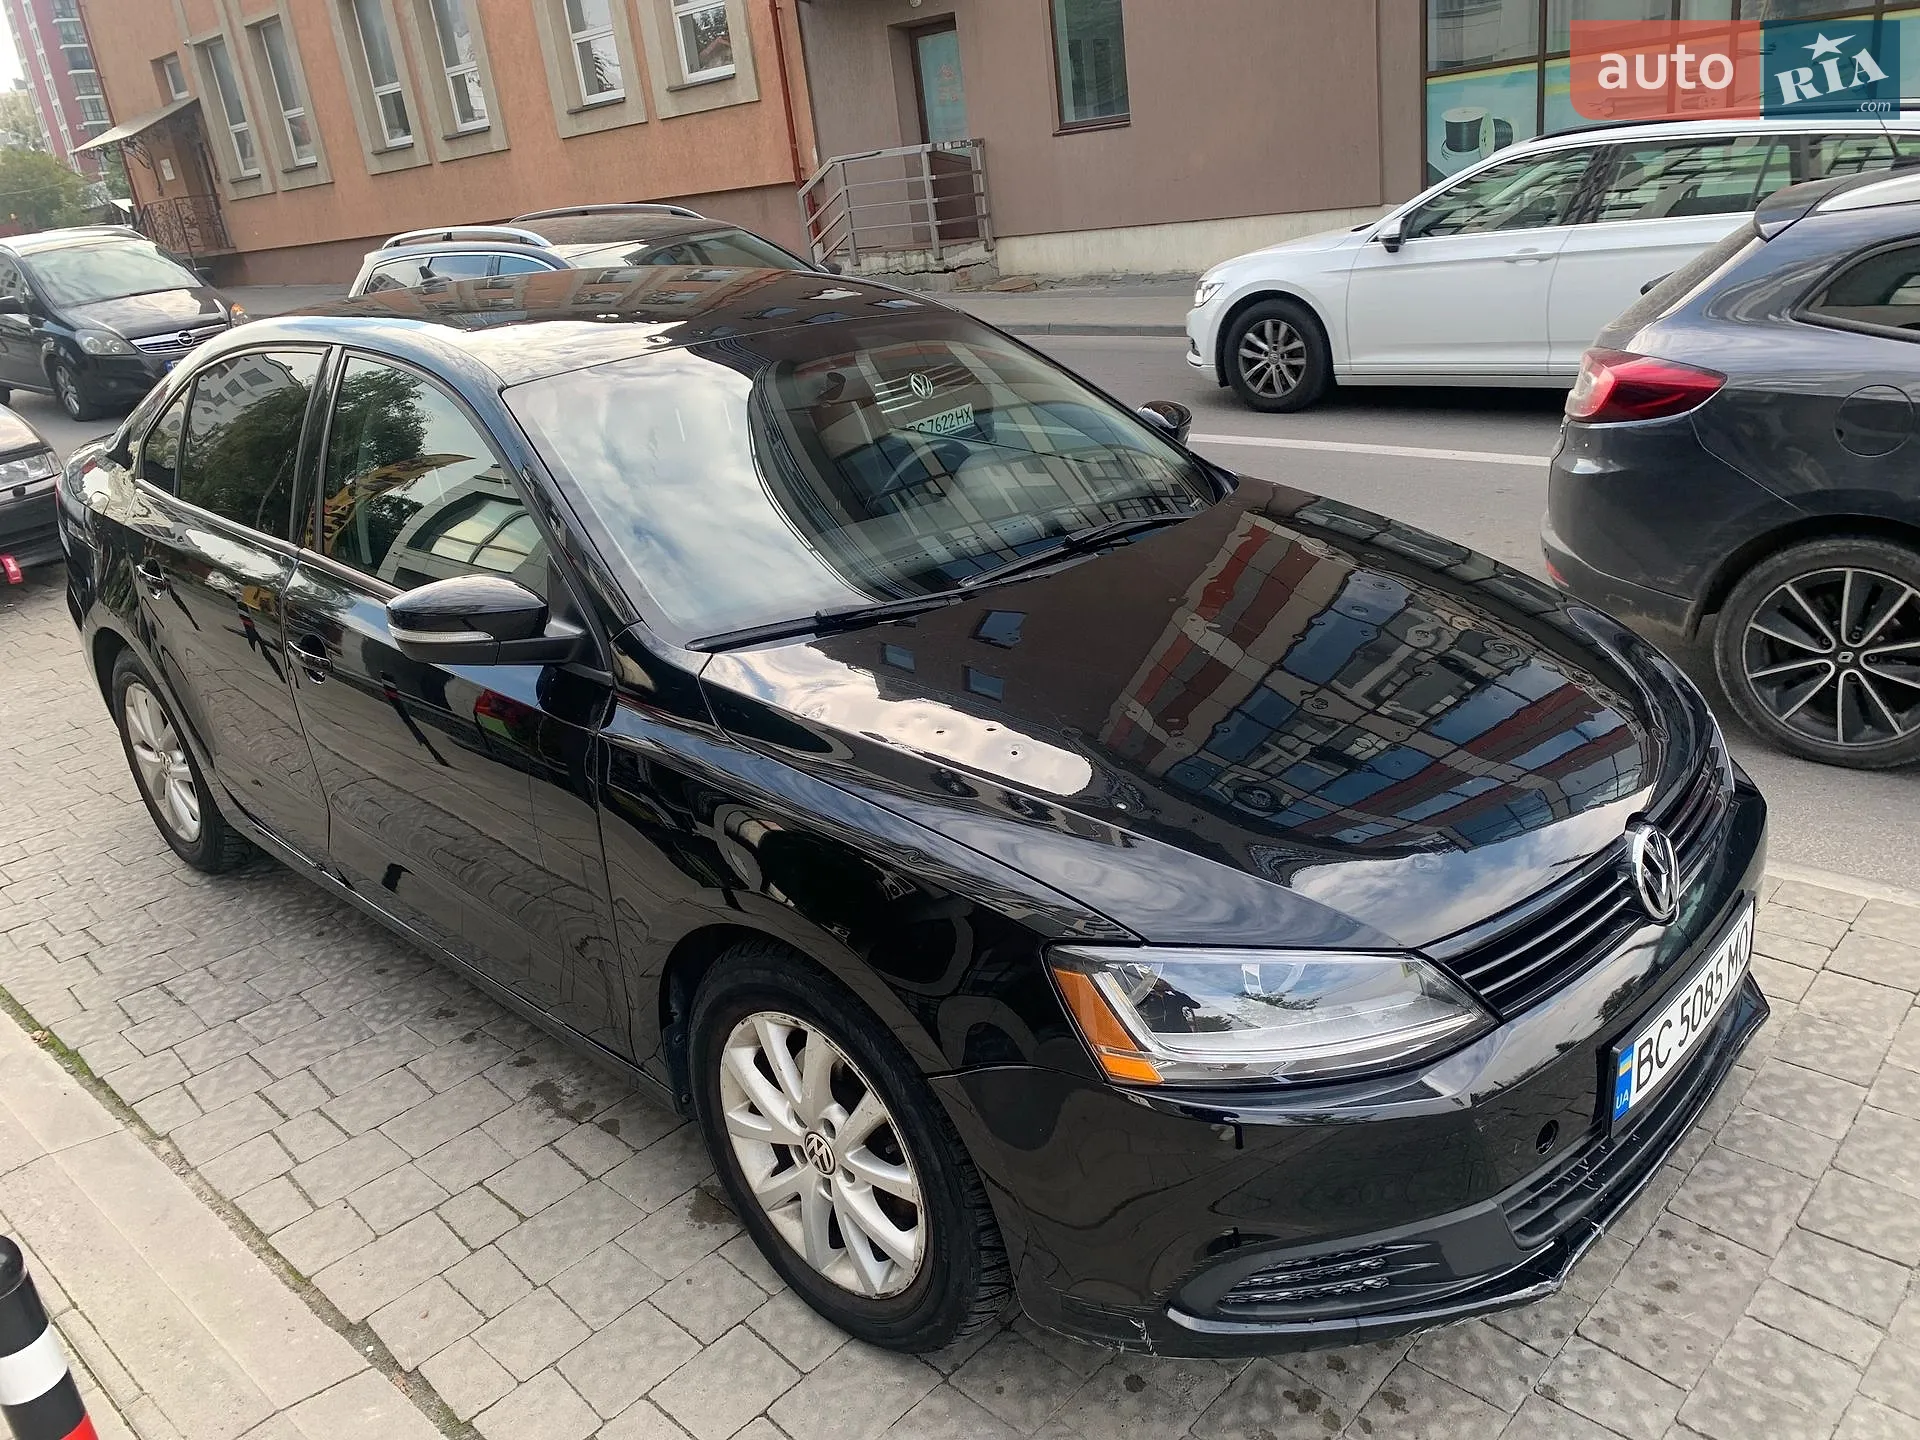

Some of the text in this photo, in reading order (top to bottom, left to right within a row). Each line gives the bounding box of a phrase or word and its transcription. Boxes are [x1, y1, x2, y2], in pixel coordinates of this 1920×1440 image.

[927, 413, 956, 433] 7622
[955, 407, 973, 424] HX
[1636, 921, 1749, 1093] BC 5085 MO
[1616, 1089, 1630, 1109] UA
